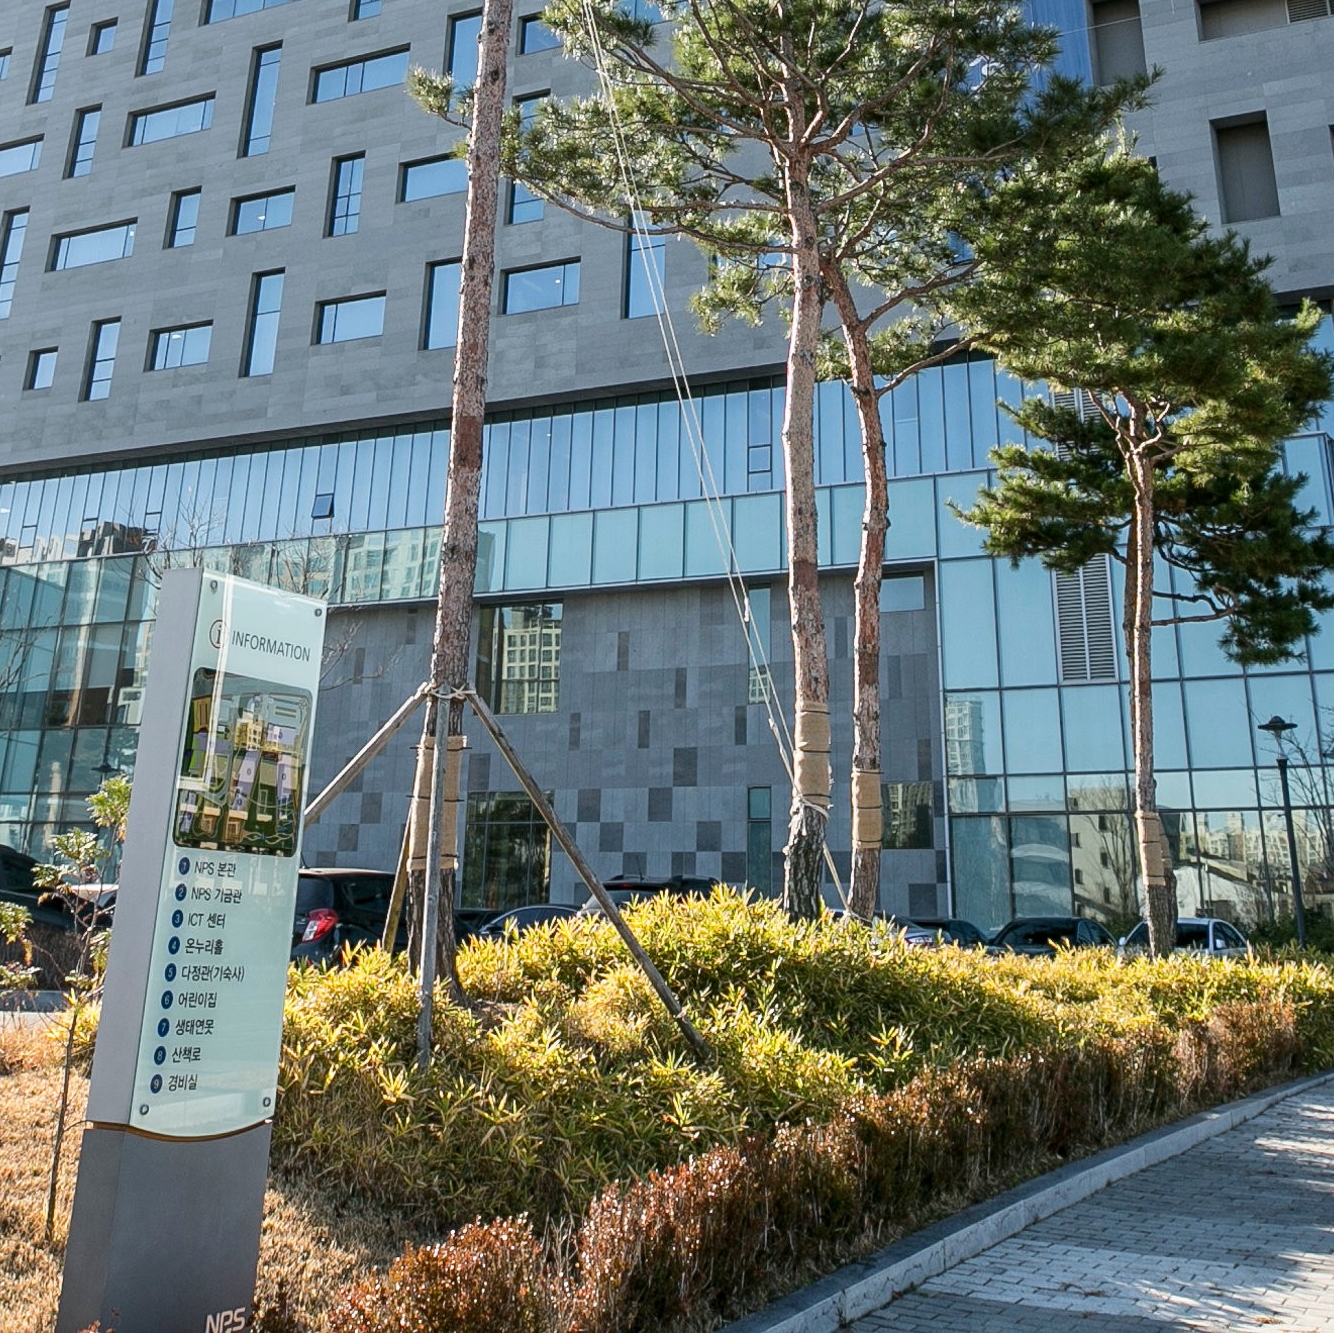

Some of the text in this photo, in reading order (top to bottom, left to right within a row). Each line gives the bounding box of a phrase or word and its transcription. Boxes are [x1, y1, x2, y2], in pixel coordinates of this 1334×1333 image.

[231, 629, 311, 663] INFORMATION
[194, 861, 215, 875] NPS
[217, 862, 236, 878] 본관
[191, 887, 212, 901] NPS
[214, 888, 242, 904] 기금관
[187, 912, 205, 926] ICT
[207, 913, 226, 928] 센터
[185, 938, 223, 955] 온누리홀
[181, 965, 244, 982] 다정관(기숙사)
[178, 992, 218, 1008] 어린이집
[175, 1019, 214, 1035] 생태연못
[171, 1047, 201, 1063] 산책로
[168, 1074, 198, 1091] 경비실
[205, 1307, 246, 1333] NPS
